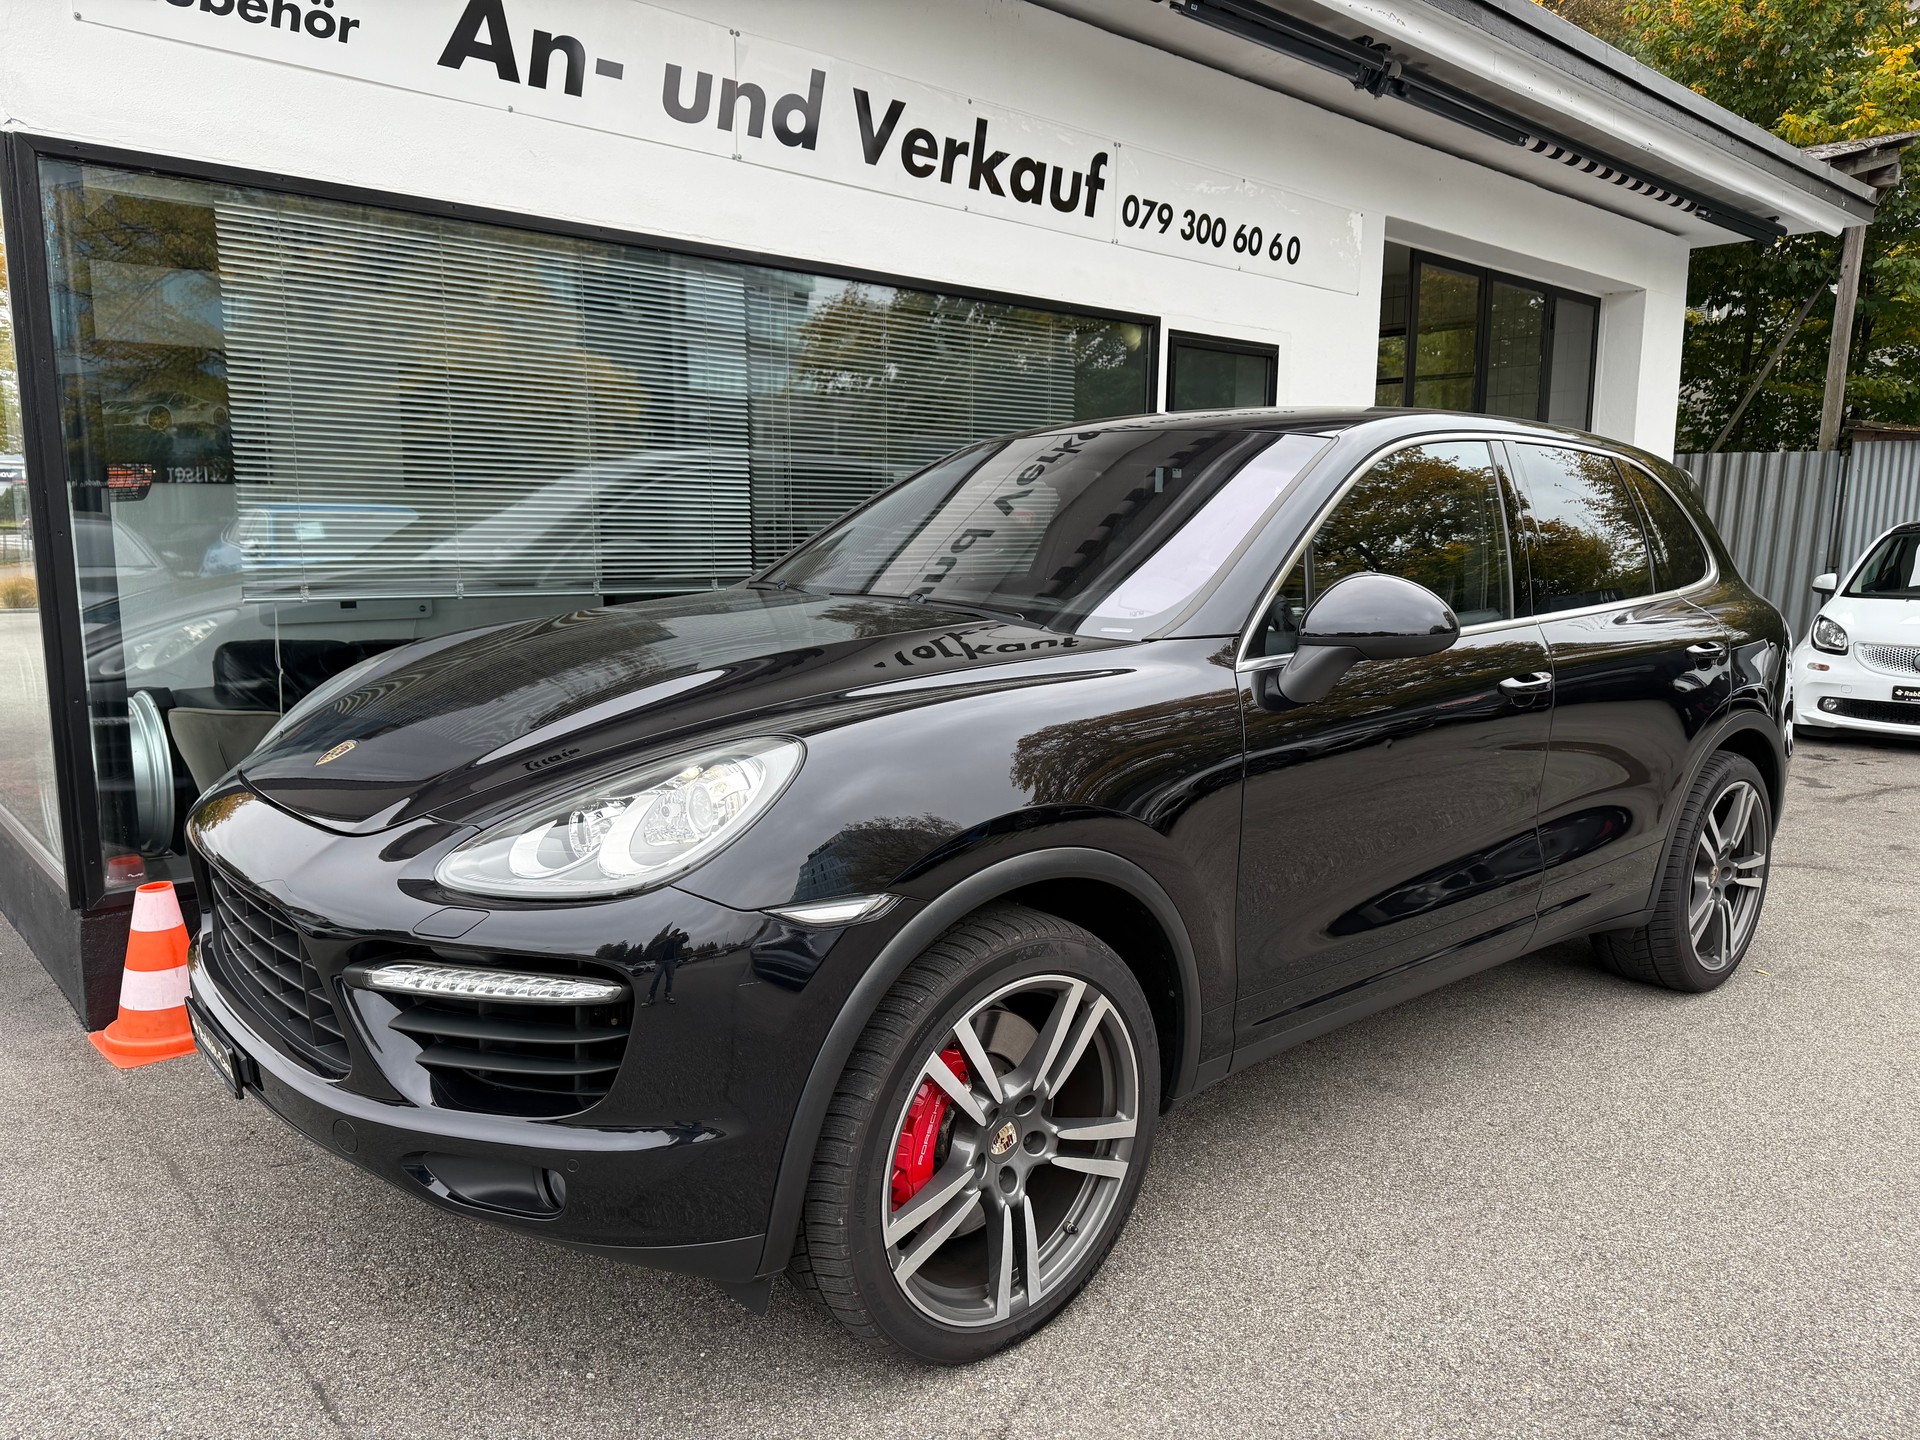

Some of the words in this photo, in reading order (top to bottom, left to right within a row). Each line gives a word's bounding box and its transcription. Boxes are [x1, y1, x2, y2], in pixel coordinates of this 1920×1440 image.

[166, 0, 360, 44] ehör
[437, 0, 624, 98] An-
[662, 68, 826, 151] und
[853, 87, 1109, 219] Verkauf
[1121, 194, 1174, 235] 079
[1180, 209, 1227, 249] 300
[1232, 223, 1263, 257] 60
[917, 1094, 942, 1165] PORSCHE
